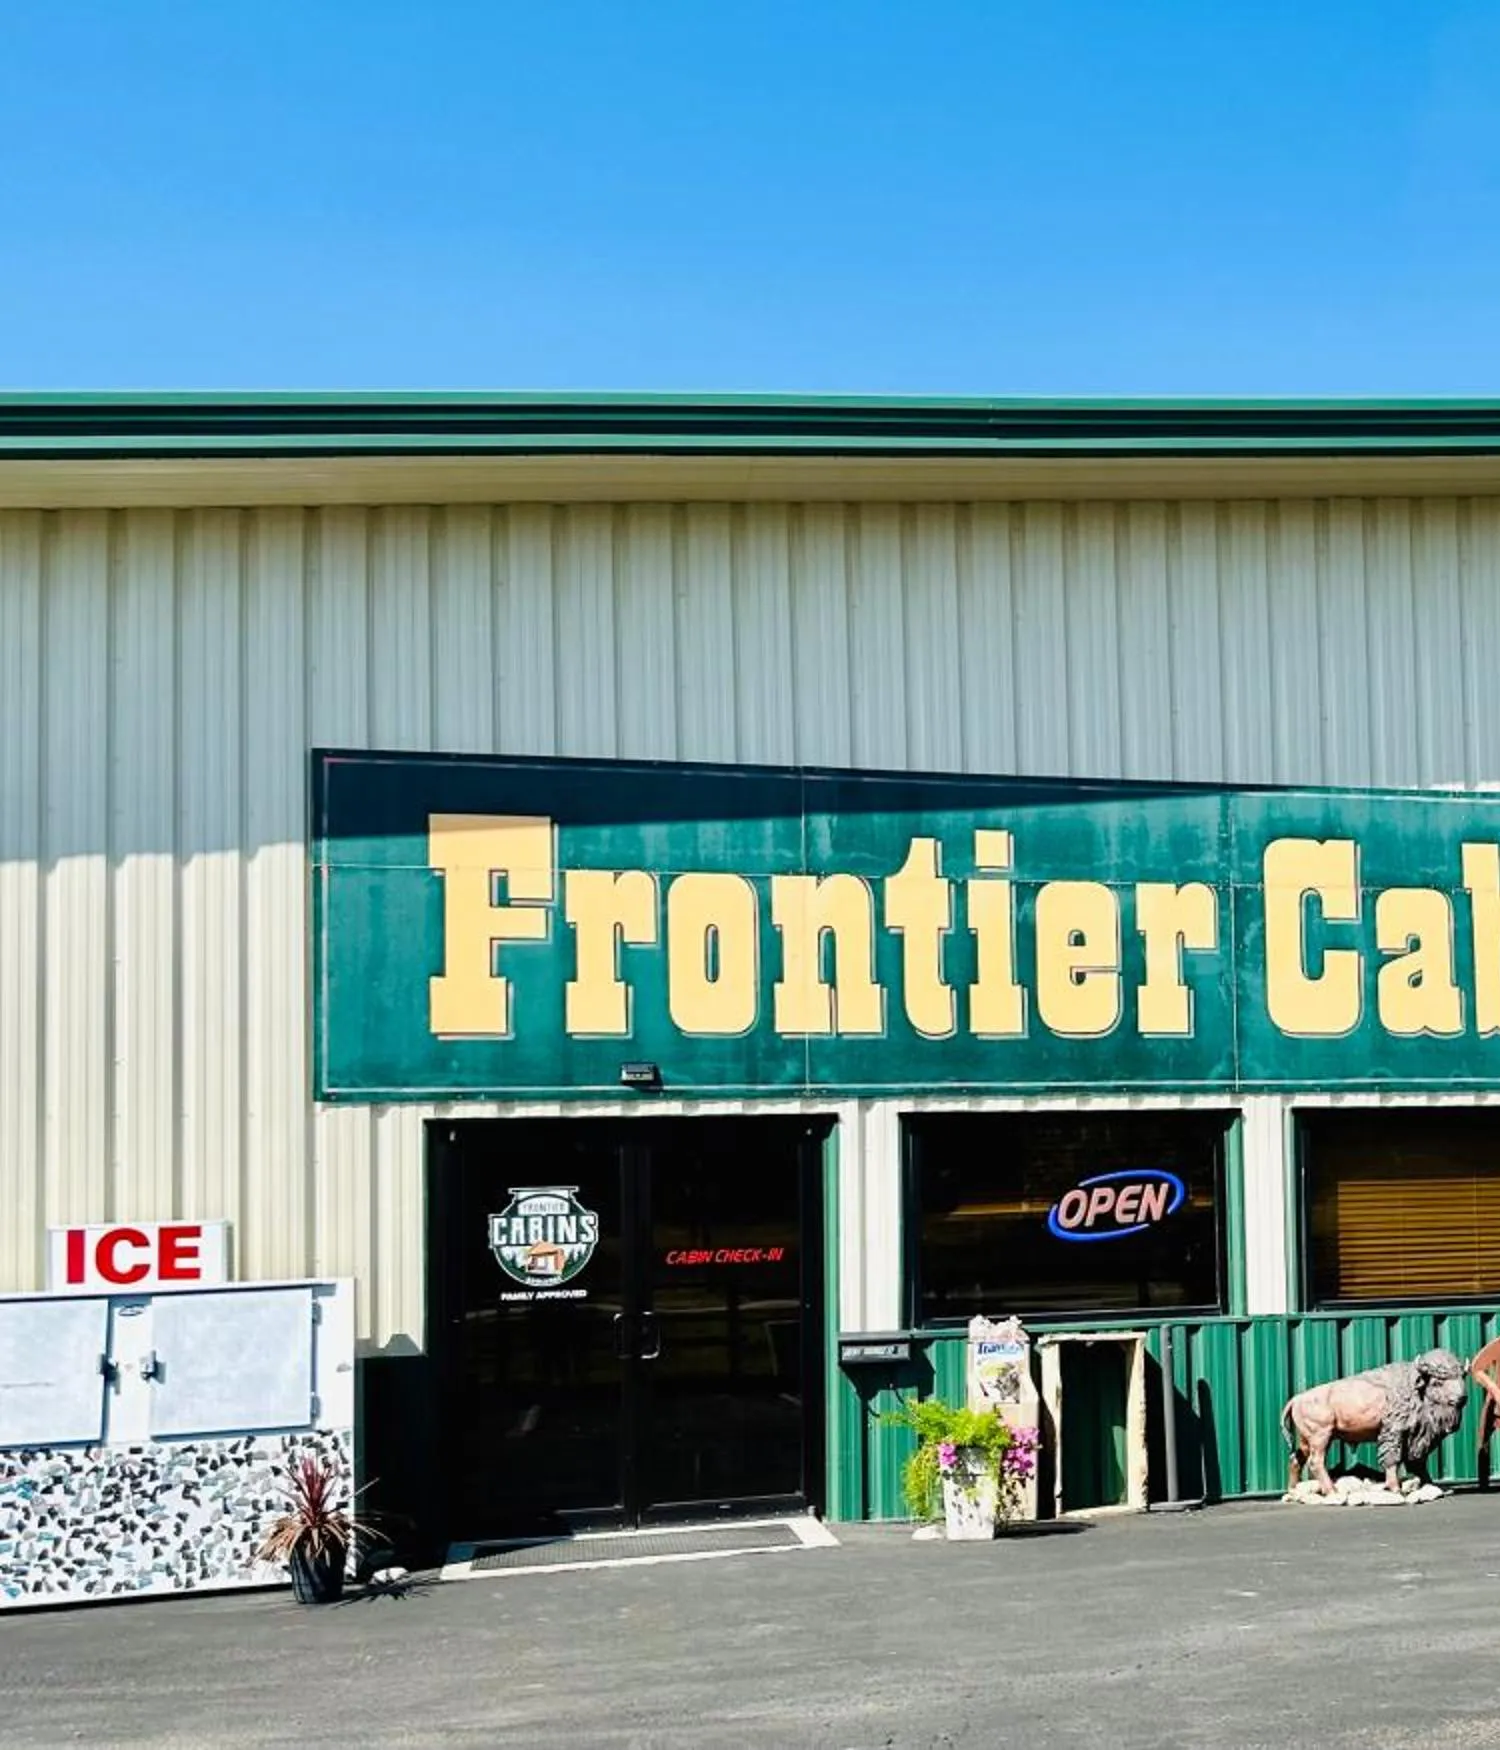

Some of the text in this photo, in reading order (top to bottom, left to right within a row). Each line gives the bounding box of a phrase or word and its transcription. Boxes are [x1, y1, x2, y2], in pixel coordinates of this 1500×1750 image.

[428, 813, 1219, 1039] Frontier
[1057, 1183, 1169, 1229] OPEN
[493, 1215, 596, 1245] CABINS
[66, 1226, 202, 1284] ICE
[665, 1247, 785, 1265] CABIN CHECK-IN
[501, 1289, 588, 1301] FAMILY APPROVED
